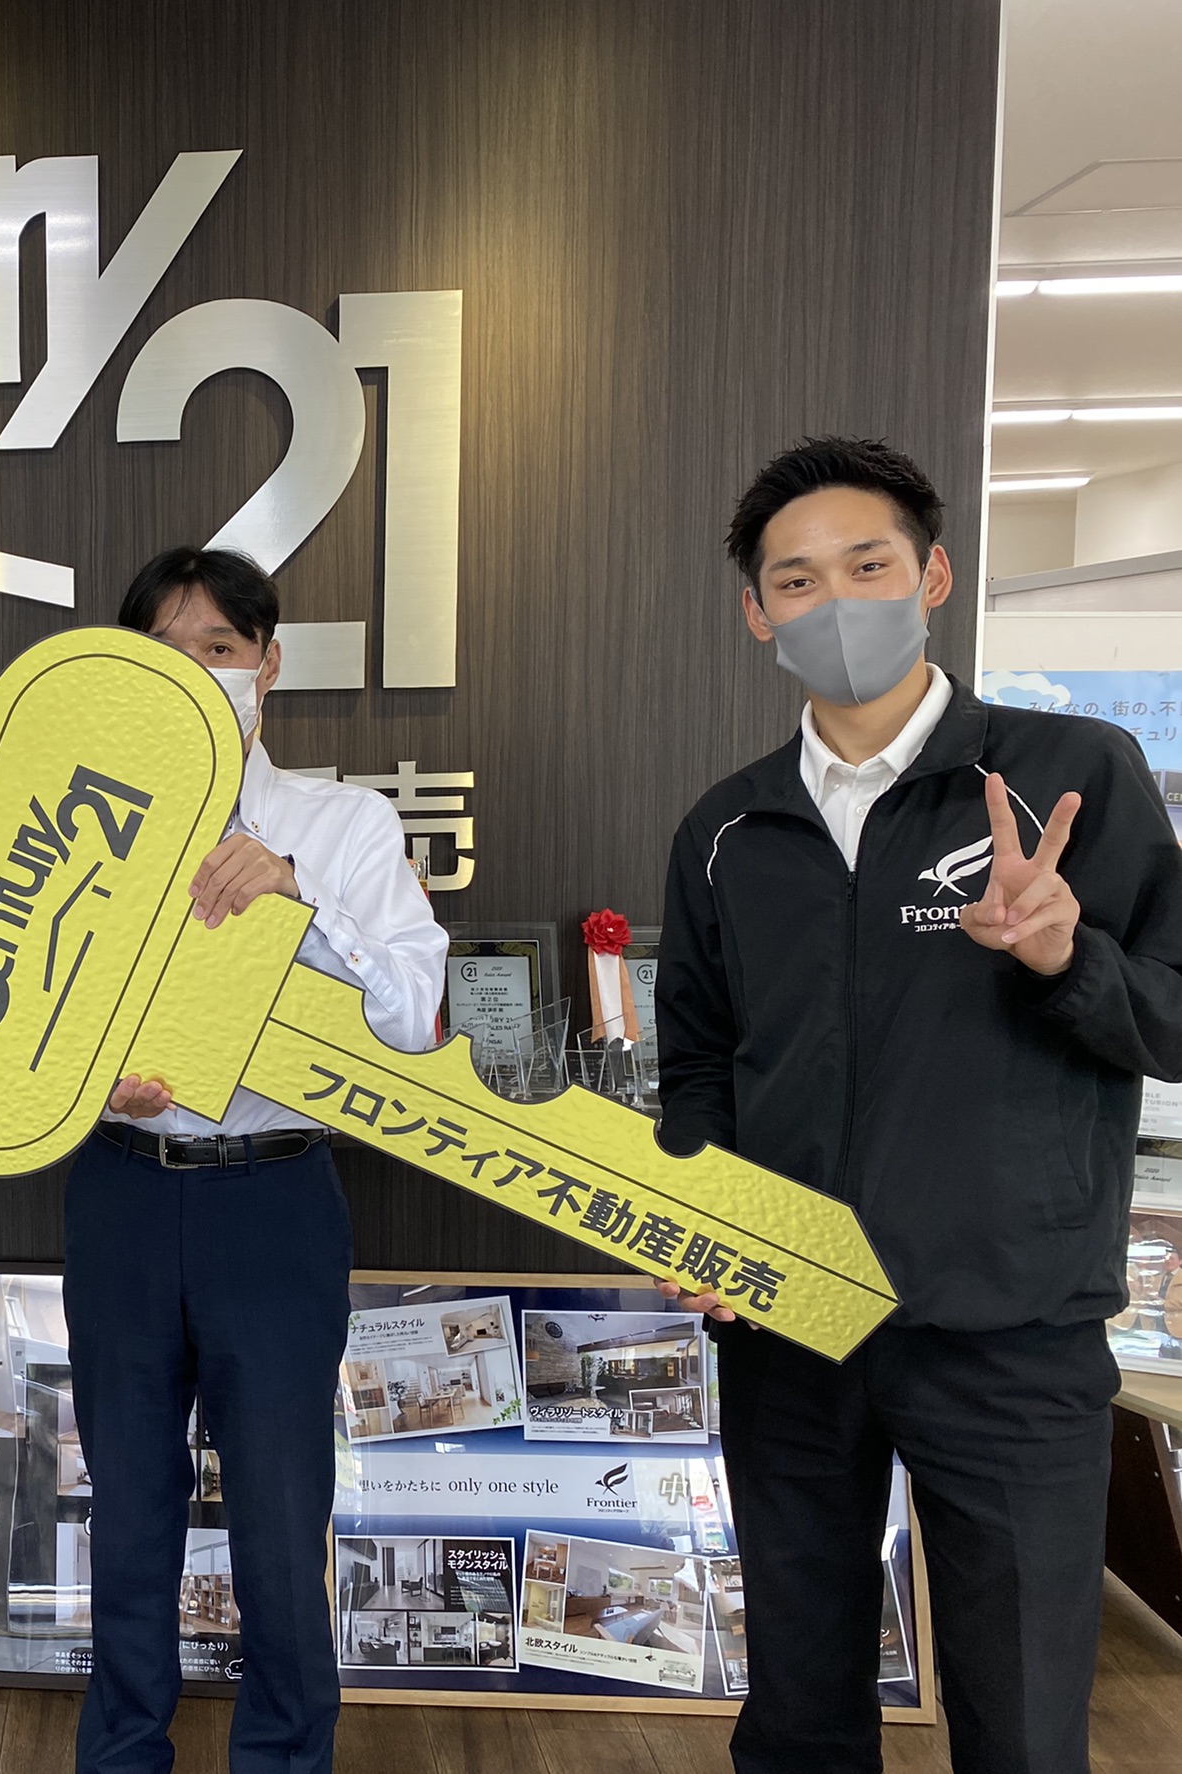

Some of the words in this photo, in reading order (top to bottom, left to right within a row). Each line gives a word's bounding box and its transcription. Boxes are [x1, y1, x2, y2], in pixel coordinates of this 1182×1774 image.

[116, 289, 464, 691] 21
[56, 764, 154, 861] 21
[900, 905, 966, 924] Fron
[303, 1062, 788, 1314] フロンティア不動産販売
[351, 1317, 425, 1334] ナチュラルスタイル
[529, 1406, 624, 1419] ヴィラリゾートスタイル
[448, 1478, 483, 1495] only
[488, 1482, 517, 1493] one
[522, 1479, 559, 1497] style
[586, 1497, 638, 1509] Frontier
[447, 1549, 506, 1560] スタイリッシュ
[447, 1559, 508, 1570] モダンスタイル
[525, 1636, 578, 1653] 北欧スタイル
